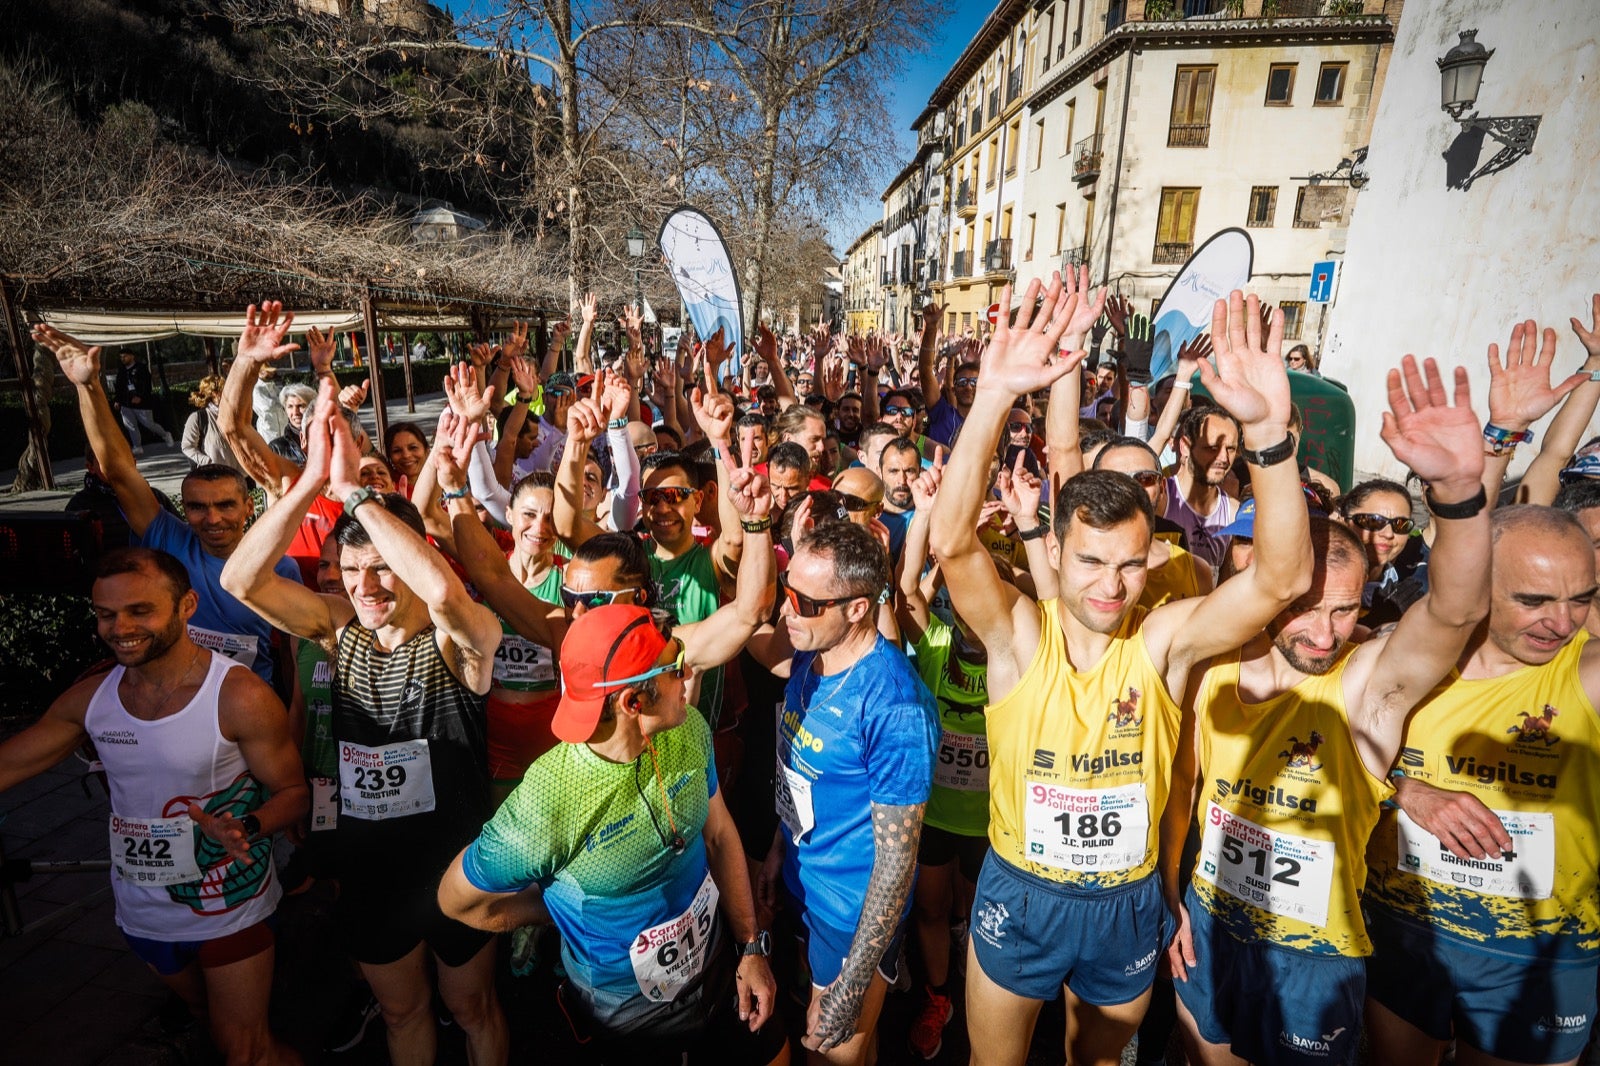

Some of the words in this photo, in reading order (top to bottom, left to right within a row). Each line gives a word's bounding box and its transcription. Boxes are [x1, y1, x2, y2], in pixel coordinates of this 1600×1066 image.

[189, 629, 223, 641] Carrera
[494, 646, 538, 664] 402
[107, 737, 138, 745] GRANADA
[784, 711, 823, 753] olimpo
[343, 746, 351, 762] 9
[351, 747, 379, 761] Carrera
[351, 756, 383, 768] Solidaria
[384, 756, 417, 766] Granada
[940, 744, 988, 769] 550
[1072, 749, 1143, 774] Vigilsa
[354, 765, 407, 791] 239
[1027, 769, 1061, 779] SEAT
[1288, 774, 1321, 785] Perdigones
[1446, 755, 1557, 789] Vigilsa
[360, 788, 400, 799] SEBASTIAN
[1443, 777, 1491, 791] Concesionario
[1492, 785, 1509, 793] SEAT
[1033, 786, 1047, 804] 9
[1048, 788, 1097, 803] Carrera
[1232, 779, 1317, 813] Vigilsa
[1048, 798, 1100, 813] Solidaria
[1100, 803, 1134, 811] Granada
[112, 817, 120, 833] 9
[120, 819, 148, 831] Carrera
[1054, 811, 1122, 838] 186
[1210, 807, 1221, 825] 9
[119, 827, 152, 838] Solidaria
[600, 814, 634, 837] olimpo
[1223, 813, 1271, 841] Carrera
[1062, 837, 1079, 848] J.C.
[1082, 839, 1114, 848] PULIDO
[1222, 822, 1273, 852] Solidaria
[1275, 837, 1293, 845] Ave
[124, 837, 172, 860] 242
[1274, 848, 1314, 862] Granada
[1222, 834, 1302, 887] 512
[1441, 853, 1503, 872] GRANADOS
[1245, 876, 1271, 892] SUSO
[650, 913, 692, 939] Carrera
[651, 918, 696, 949] Solidaria
[637, 934, 650, 954] 9
[657, 907, 711, 967] 615
[1135, 949, 1157, 969] BAYDA
[1555, 1014, 1587, 1028] BAYDA
[1293, 1033, 1330, 1052] BAYDA
